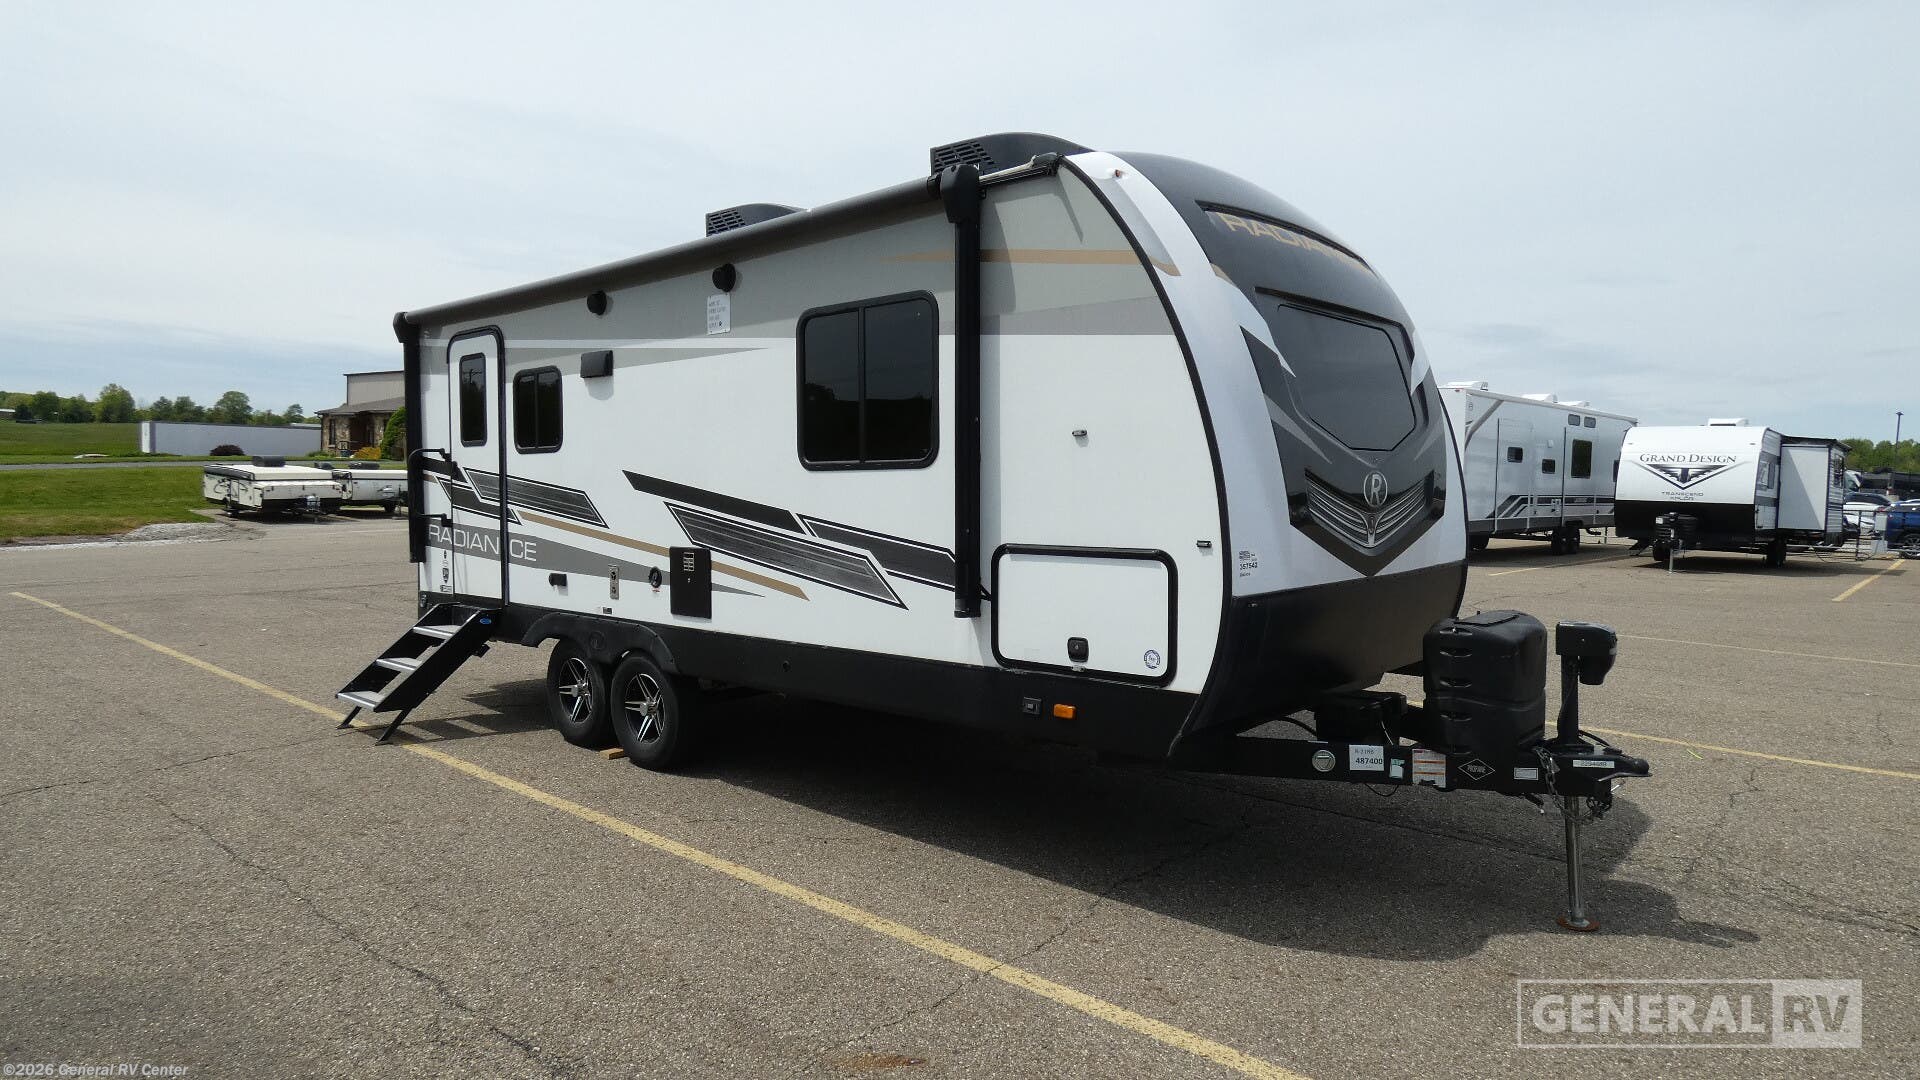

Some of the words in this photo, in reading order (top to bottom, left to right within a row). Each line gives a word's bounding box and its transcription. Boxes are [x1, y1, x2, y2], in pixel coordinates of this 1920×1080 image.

[1639, 453, 1686, 463] GRAND
[1688, 453, 1737, 464] DESIGN
[428, 524, 537, 562] RADIANCE
[1355, 757, 1383, 765] 487400
